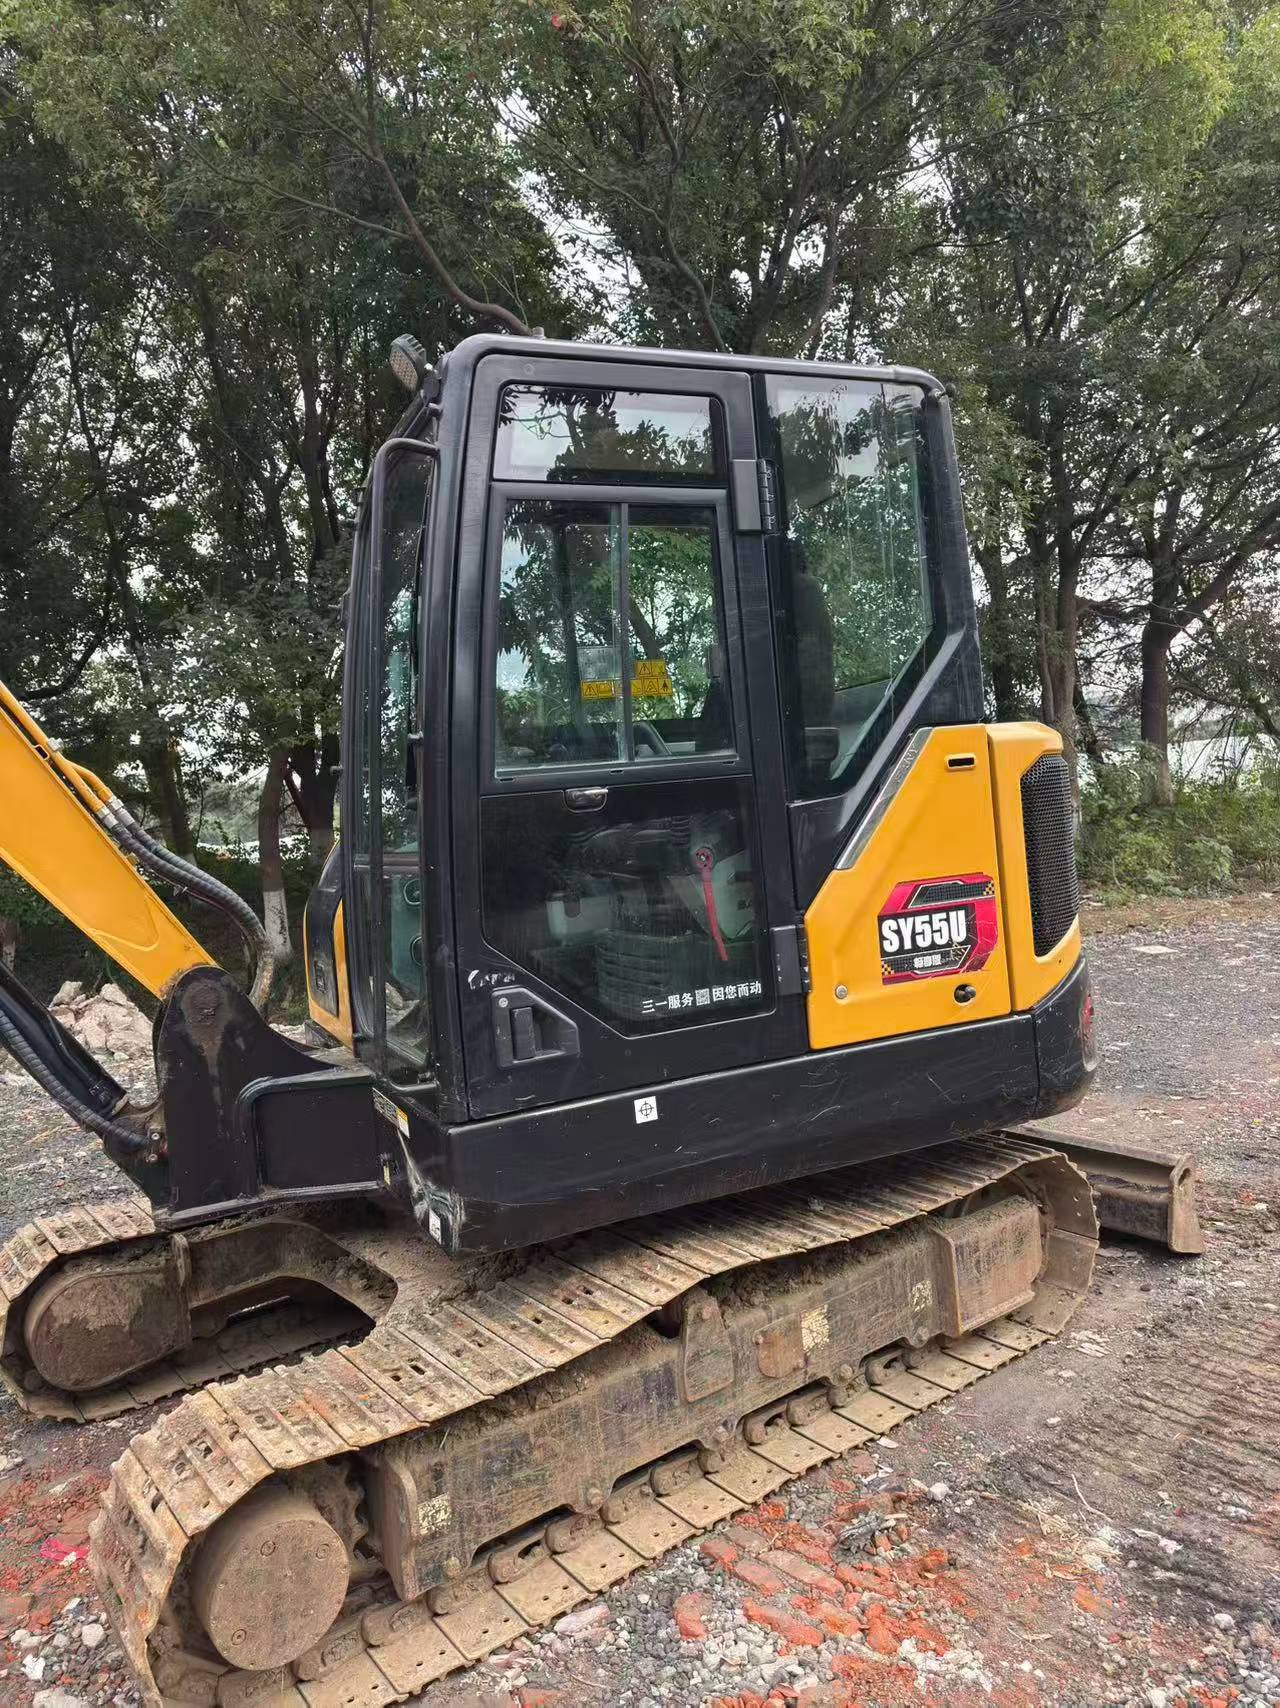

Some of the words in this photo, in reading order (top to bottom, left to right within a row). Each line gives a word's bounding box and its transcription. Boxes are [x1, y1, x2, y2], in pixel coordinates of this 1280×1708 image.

[881, 910, 967, 953] SY55U
[641, 992, 694, 1014] 三一服务
[712, 980, 762, 1002] 因您而动
